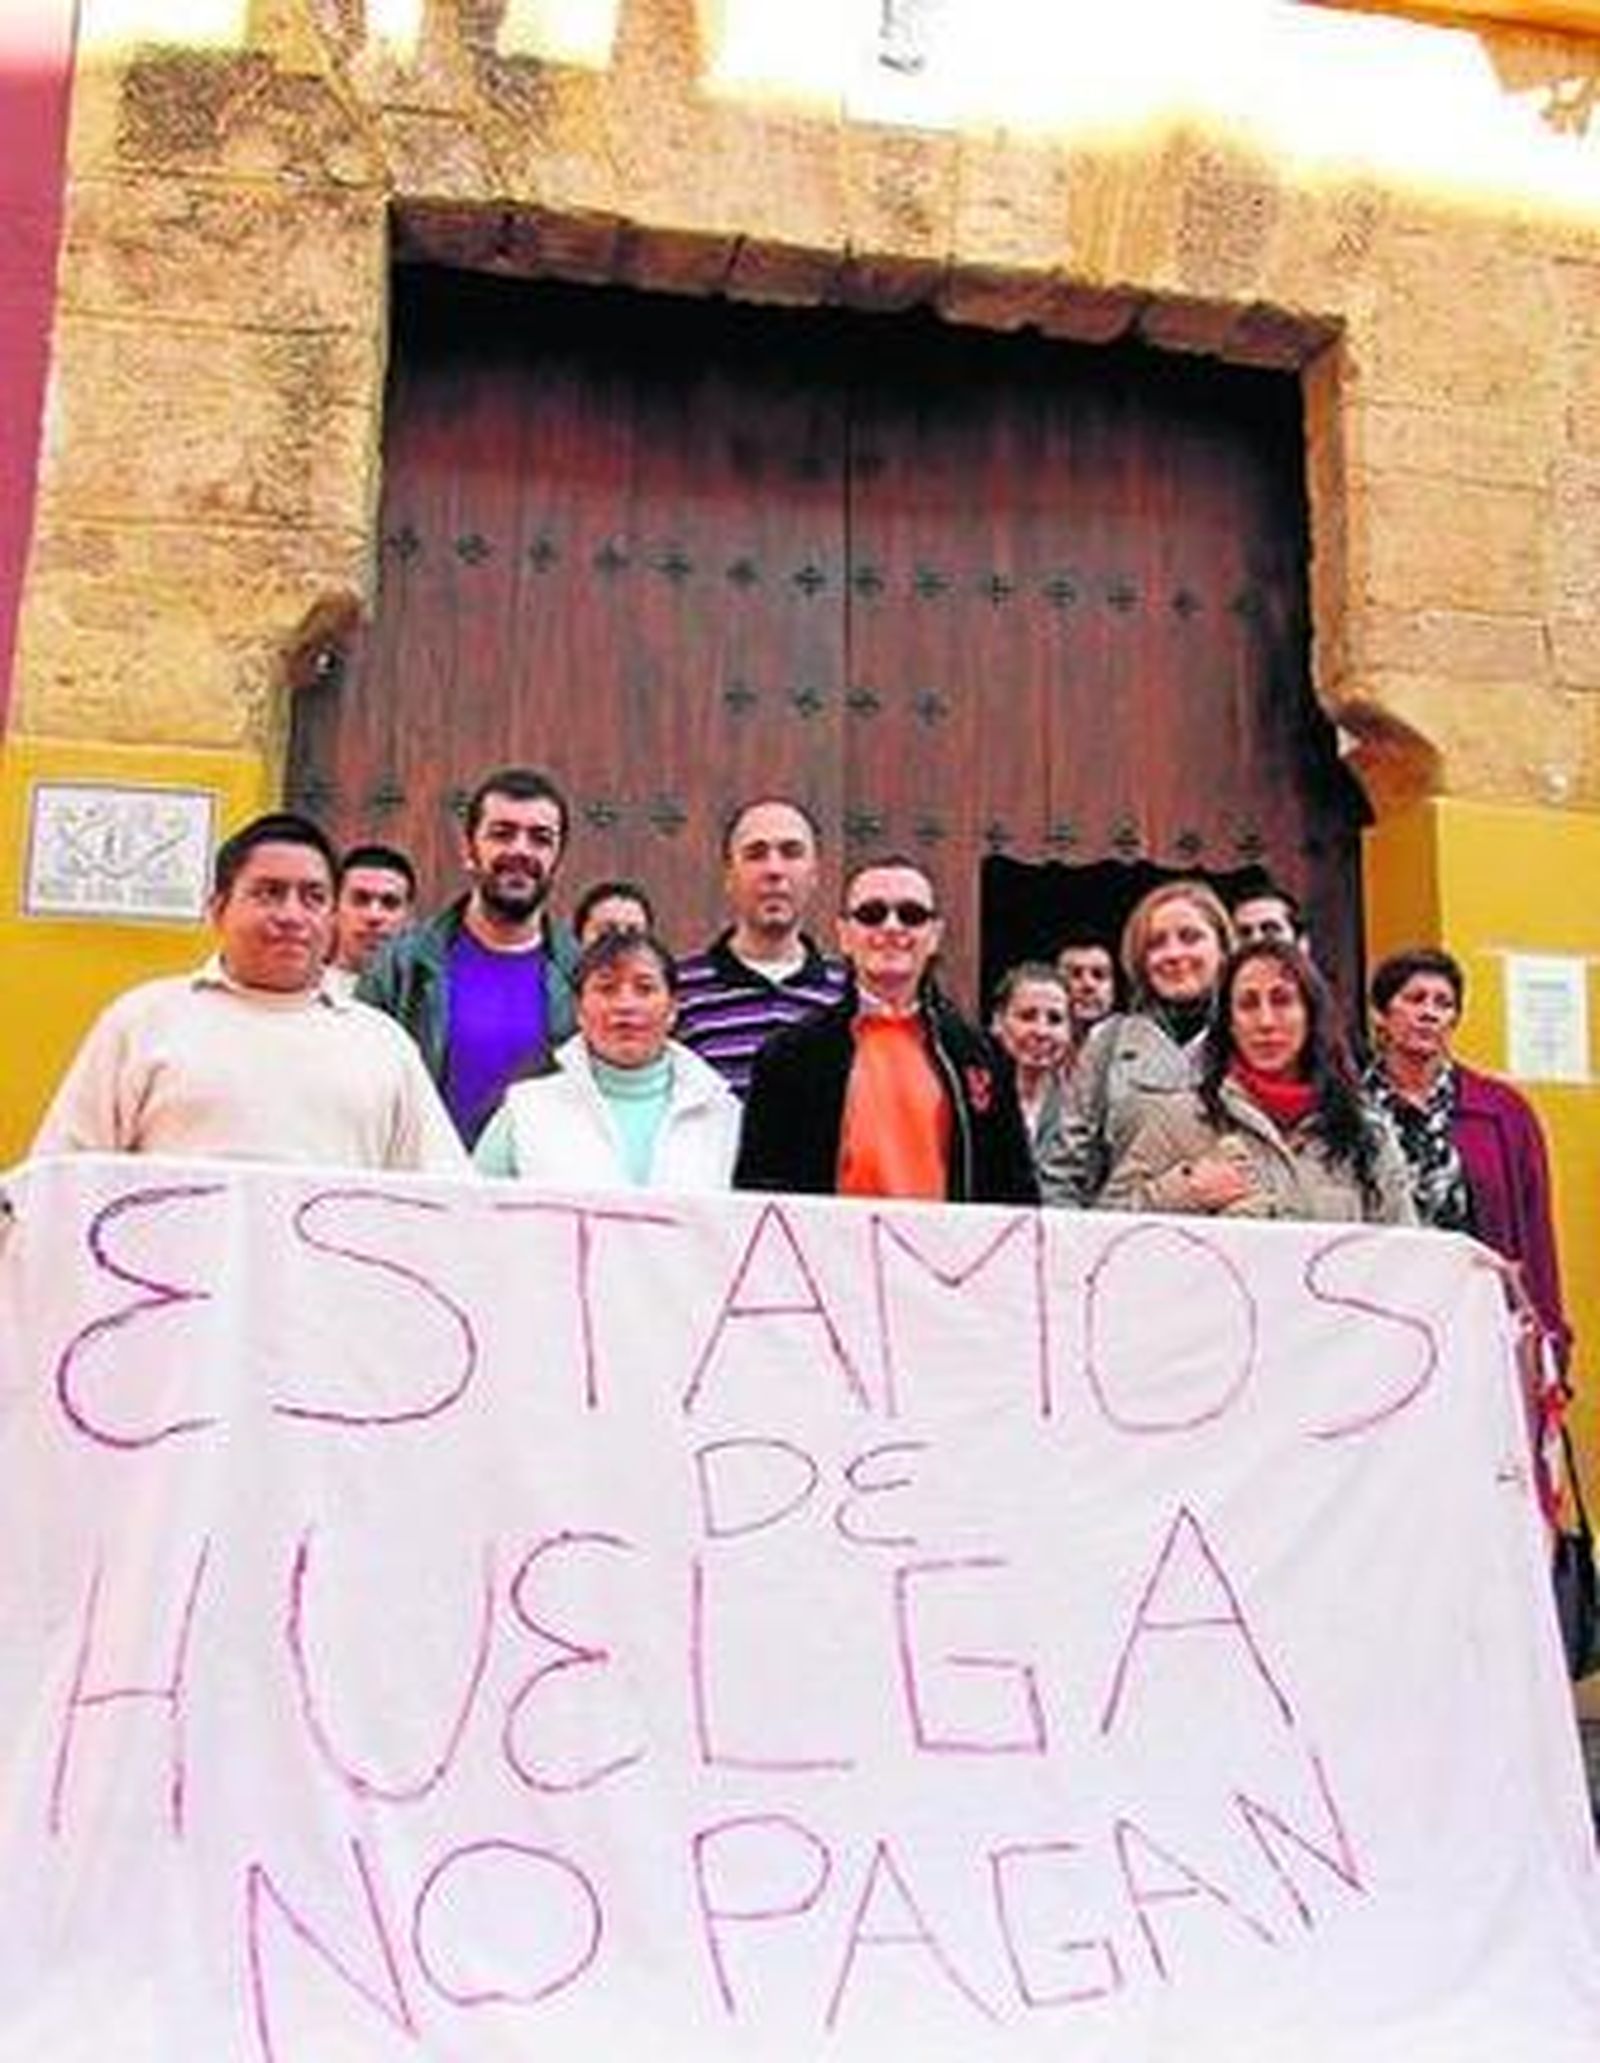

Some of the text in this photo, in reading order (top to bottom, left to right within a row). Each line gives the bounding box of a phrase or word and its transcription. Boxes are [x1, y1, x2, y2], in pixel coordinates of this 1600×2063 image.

[58, 1184, 1439, 1449] ESTAMOS
[694, 1438, 932, 1545] DE
[48, 1507, 1295, 1840] HUELGA
[247, 1755, 1365, 2063] NO PAGAN
